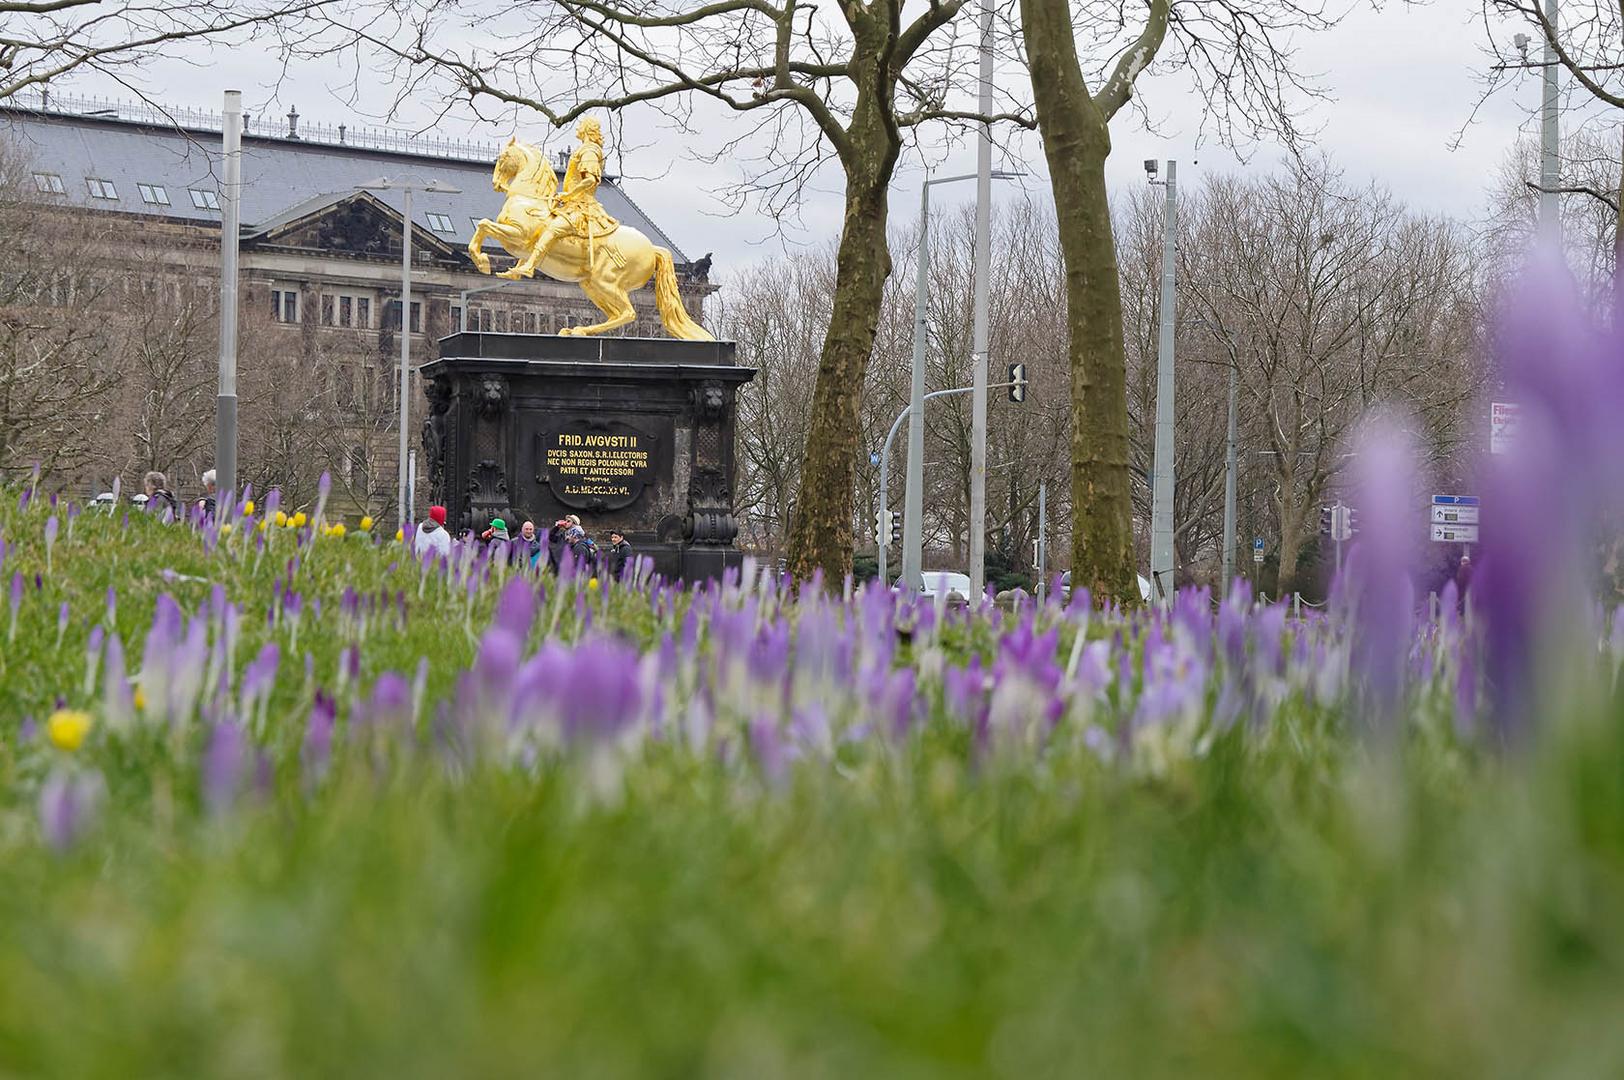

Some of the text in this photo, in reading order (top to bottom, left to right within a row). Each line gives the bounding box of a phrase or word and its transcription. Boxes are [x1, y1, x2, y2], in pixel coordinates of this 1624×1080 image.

[559, 435, 637, 448] FRID. AVGVSTI II
[547, 449, 567, 457] DVCIS
[547, 458, 560, 466] NEC
[577, 459, 597, 467] REGIS
[598, 459, 629, 468] POLONIAE
[630, 460, 648, 468] CVRA
[580, 467, 589, 475] ET
[589, 467, 634, 476] ANTECESSORI
[1255, 538, 1262, 548] P
